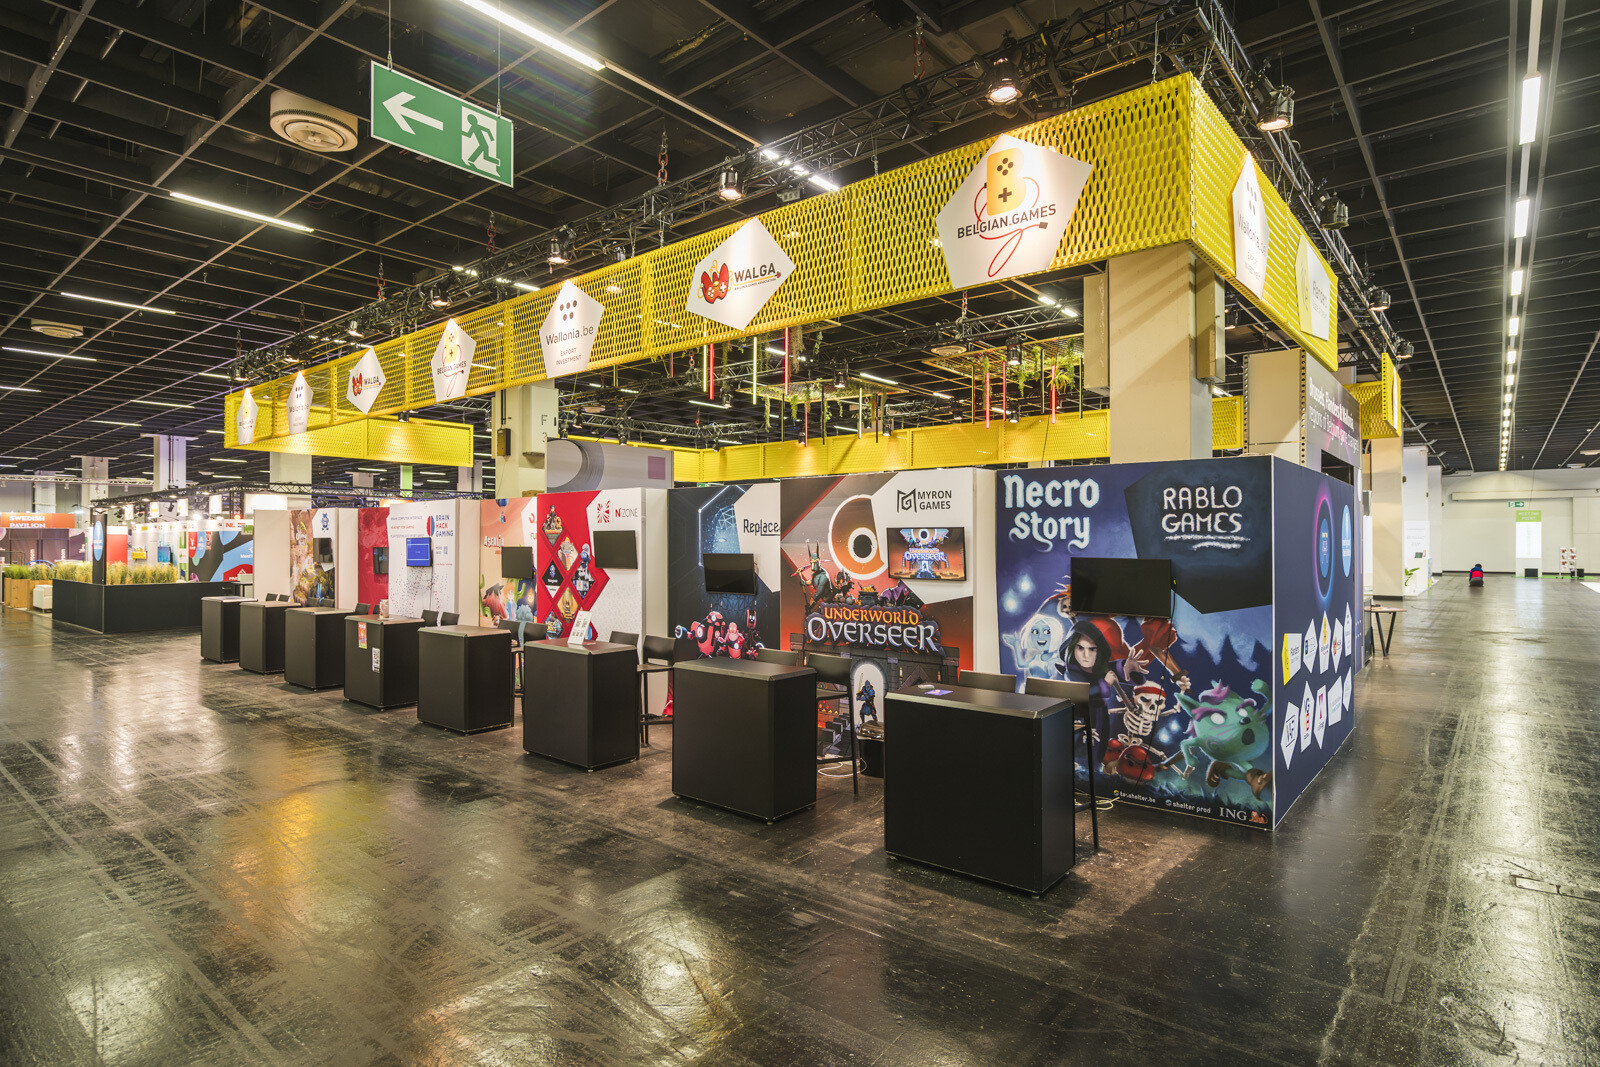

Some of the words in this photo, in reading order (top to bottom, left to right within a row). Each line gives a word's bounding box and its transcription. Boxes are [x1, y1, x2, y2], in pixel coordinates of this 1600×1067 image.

[957, 203, 1057, 239] BELGIAN.GAMES
[734, 262, 776, 283] WALGA
[545, 325, 594, 346] Wallonia.be
[560, 347, 577, 357] EXPORT
[555, 354, 582, 366] INVESTMENT
[363, 376, 380, 386] WALGA
[541, 414, 548, 425] F
[917, 490, 952, 500] MYRON
[1163, 485, 1243, 510] RABLO
[919, 500, 951, 510] GAMES
[743, 518, 780, 537] Replace
[1161, 511, 1243, 534] GAMES
[435, 529, 454, 537] GAMING
[823, 606, 919, 626] UNDERWORLD
[807, 616, 939, 652] OVERSEER
[1172, 801, 1195, 812] shelter
[1196, 806, 1212, 814] prod
[1219, 806, 1248, 821] ING
